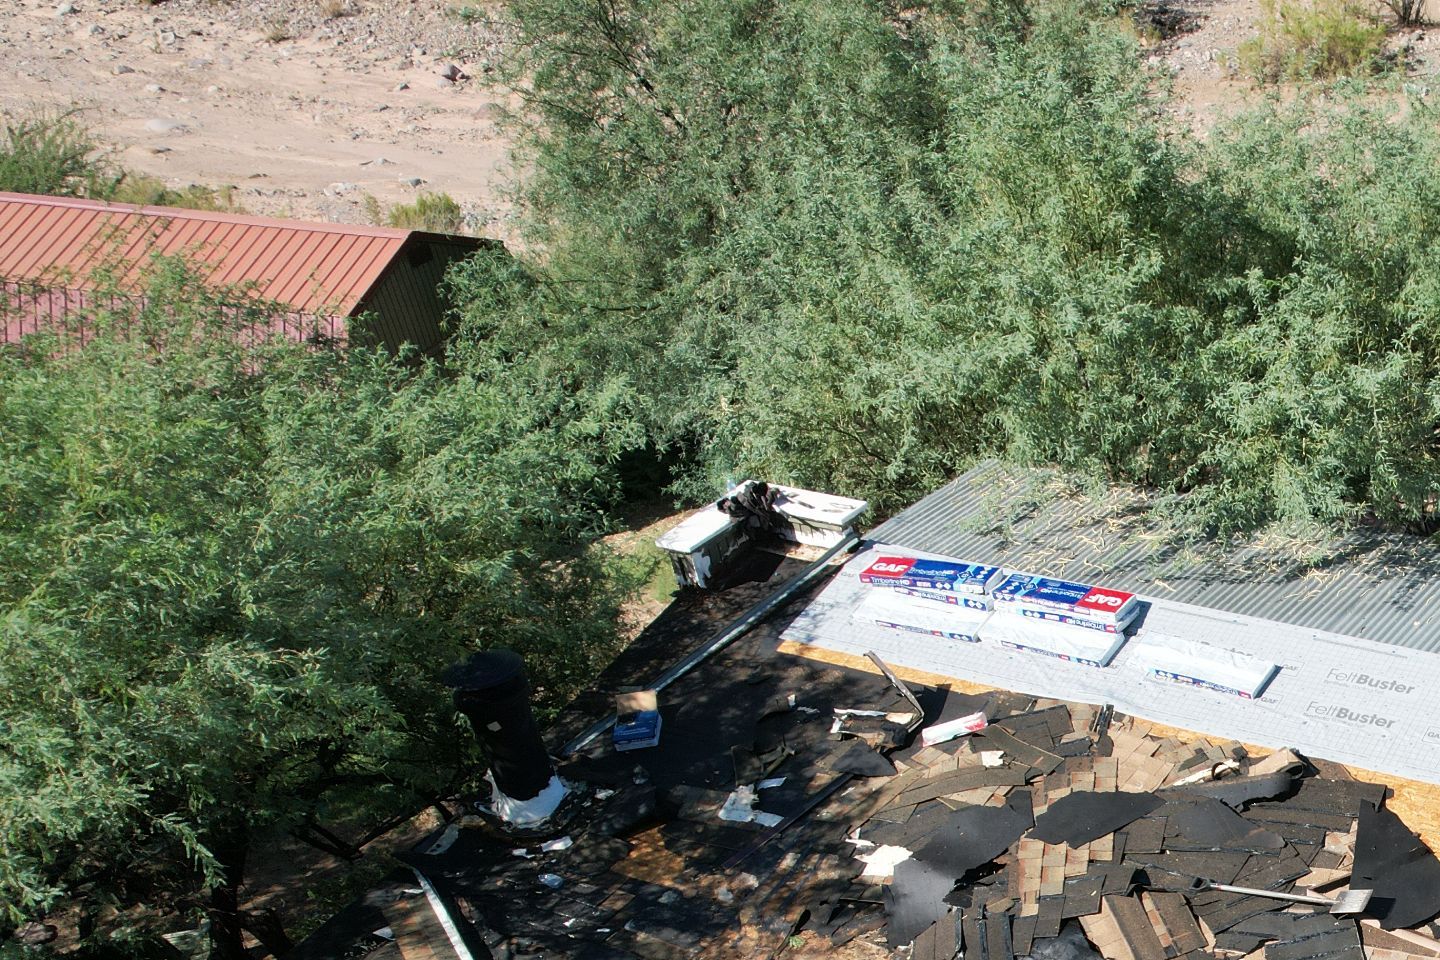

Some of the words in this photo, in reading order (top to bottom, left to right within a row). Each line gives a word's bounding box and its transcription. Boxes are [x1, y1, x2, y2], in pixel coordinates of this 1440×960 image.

[871, 562, 909, 573] GAF
[1085, 593, 1123, 607] GAF
[1326, 667, 1416, 695] FeltBuster
[1305, 700, 1396, 729] FeltBuster
